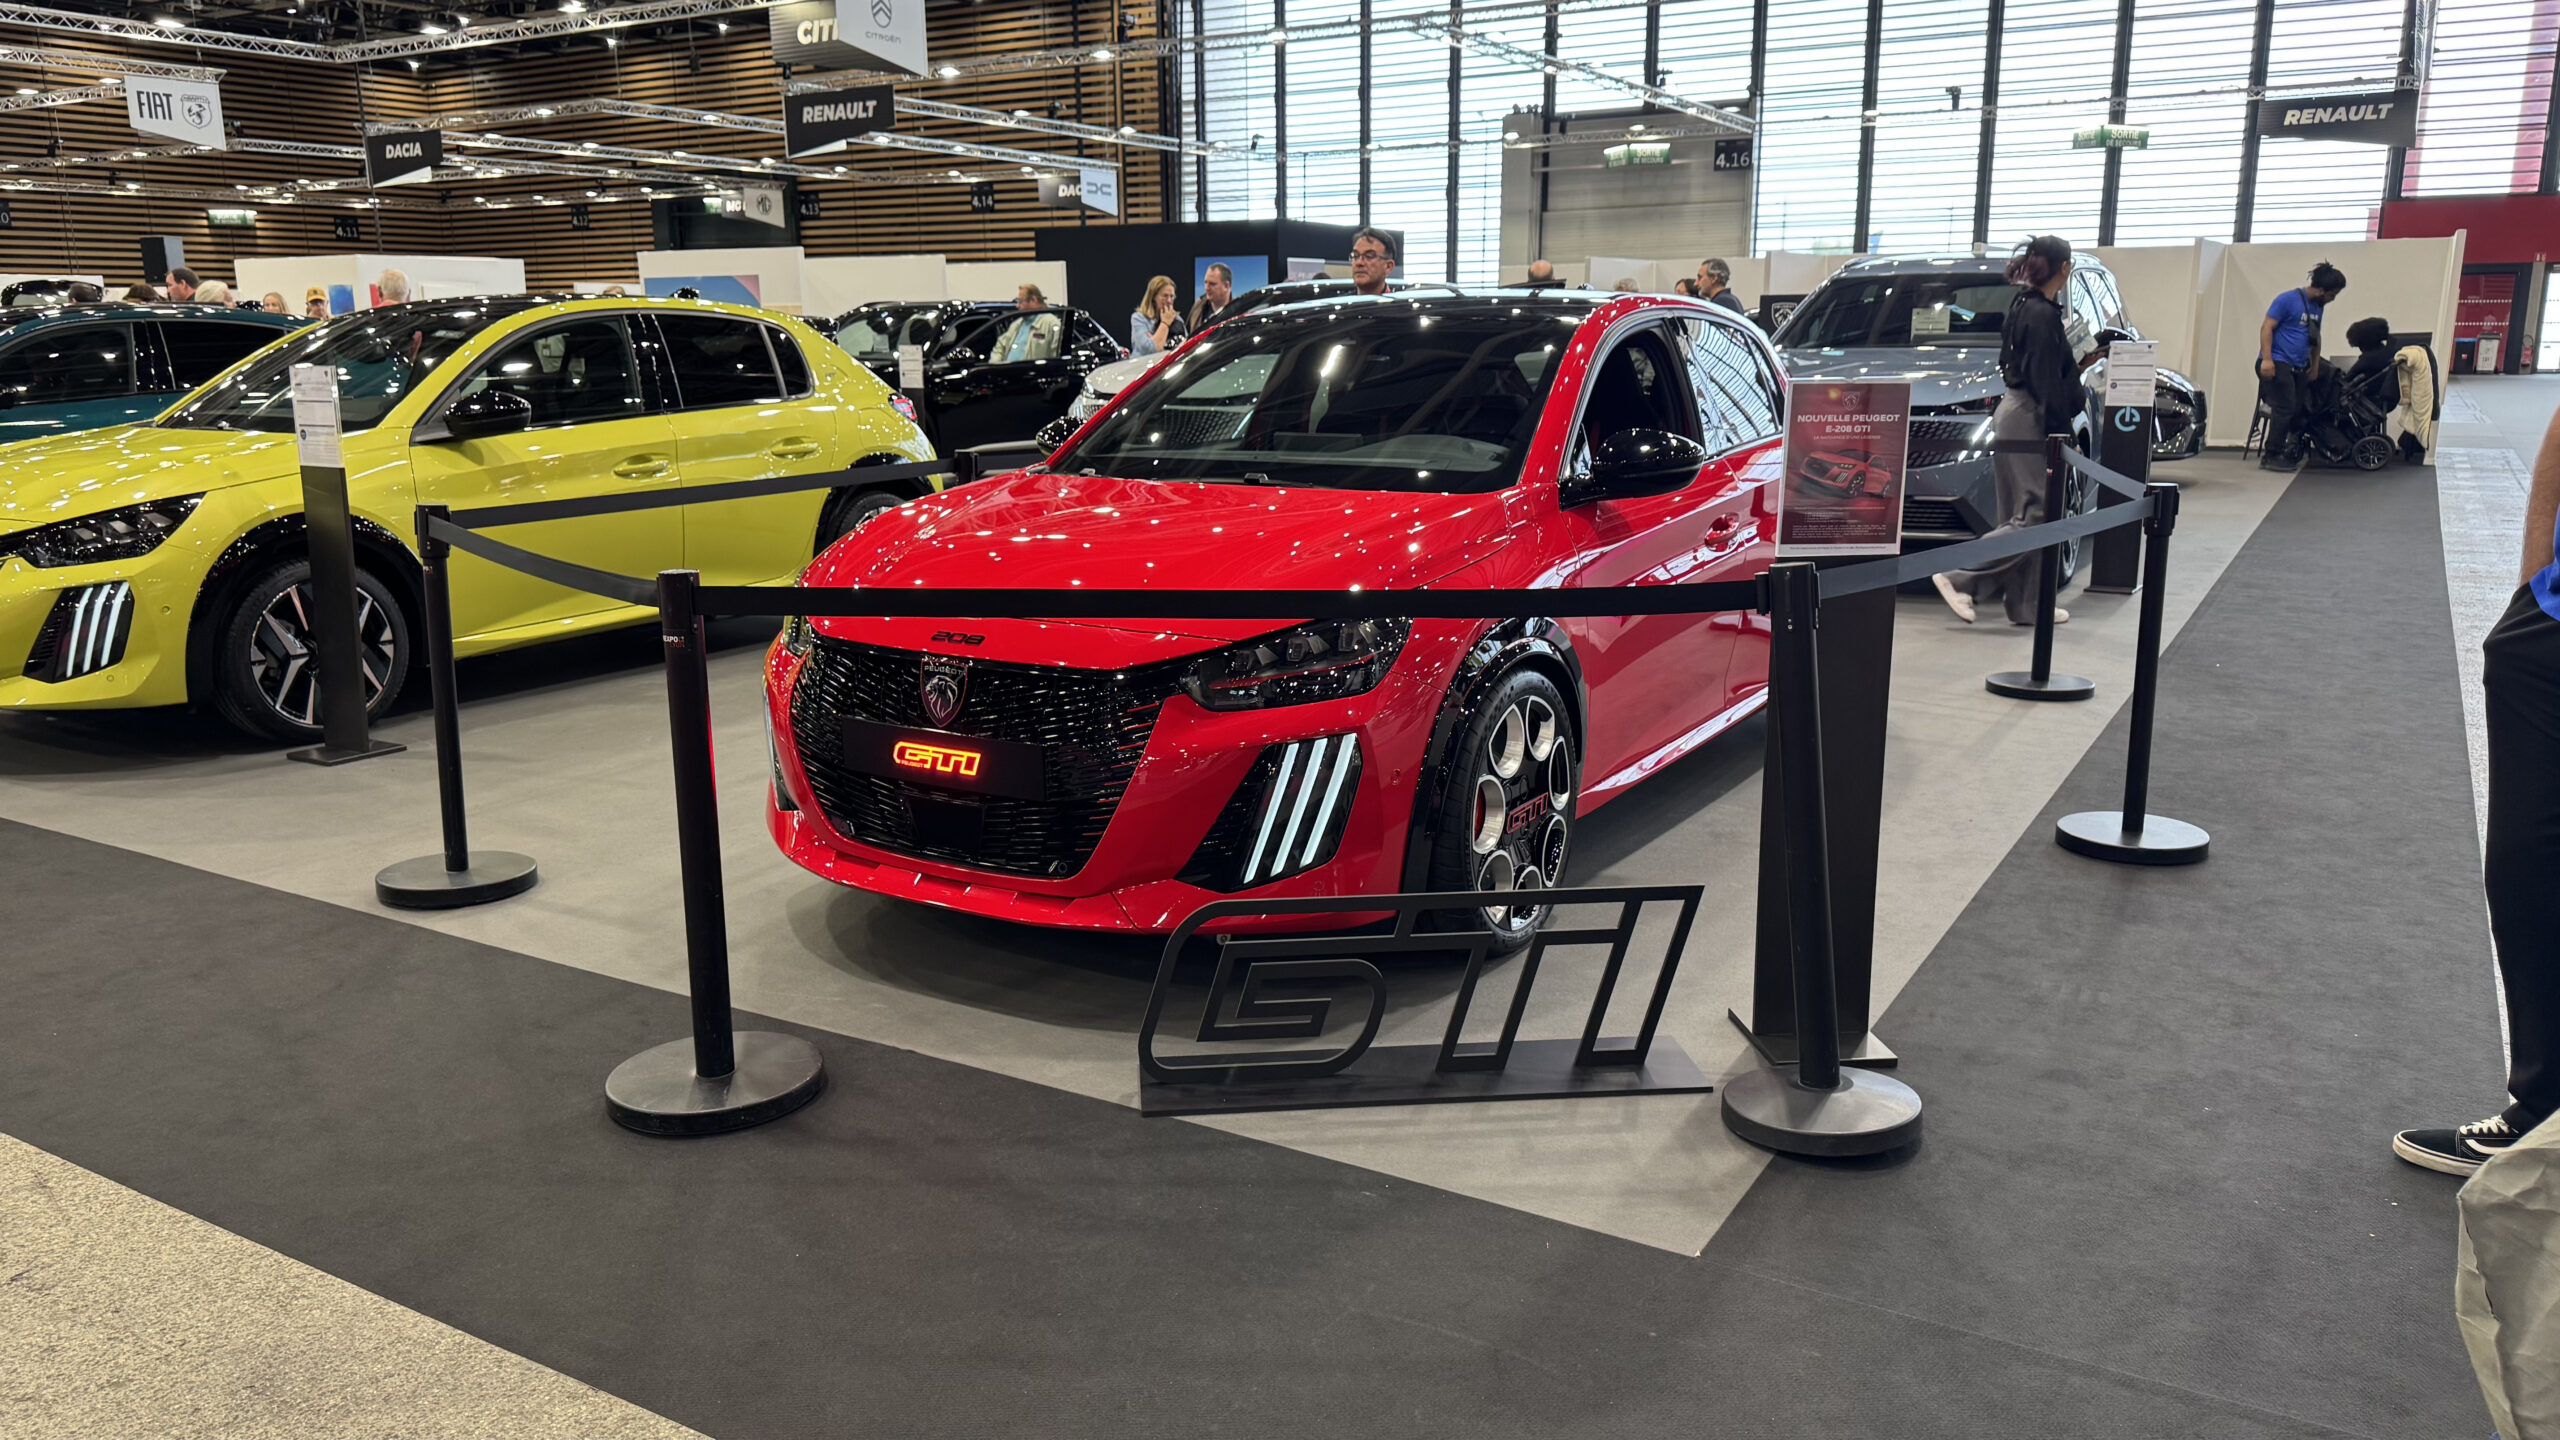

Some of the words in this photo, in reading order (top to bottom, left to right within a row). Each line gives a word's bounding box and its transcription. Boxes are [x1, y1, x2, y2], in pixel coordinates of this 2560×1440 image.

[136, 90, 173, 121] FIAT
[802, 100, 877, 124] RENAULT
[2283, 103, 2394, 126] RENAULT
[2111, 128, 2140, 139] SORTIE
[385, 141, 422, 159] DACIA
[1715, 152, 1750, 168] 4.16
[972, 195, 993, 207] 4.14
[1797, 415, 1850, 423] NOUVELLE
[1853, 414, 1900, 422] PEUGEOT
[1826, 425, 1852, 433] E-208
[1854, 425, 1871, 433] GTI
[931, 631, 986, 646] 208
[924, 664, 966, 675] PEUGEOT
[893, 741, 981, 777] GTI
[1507, 792, 1549, 834] GTI
[1138, 885, 1704, 1084] GTI
